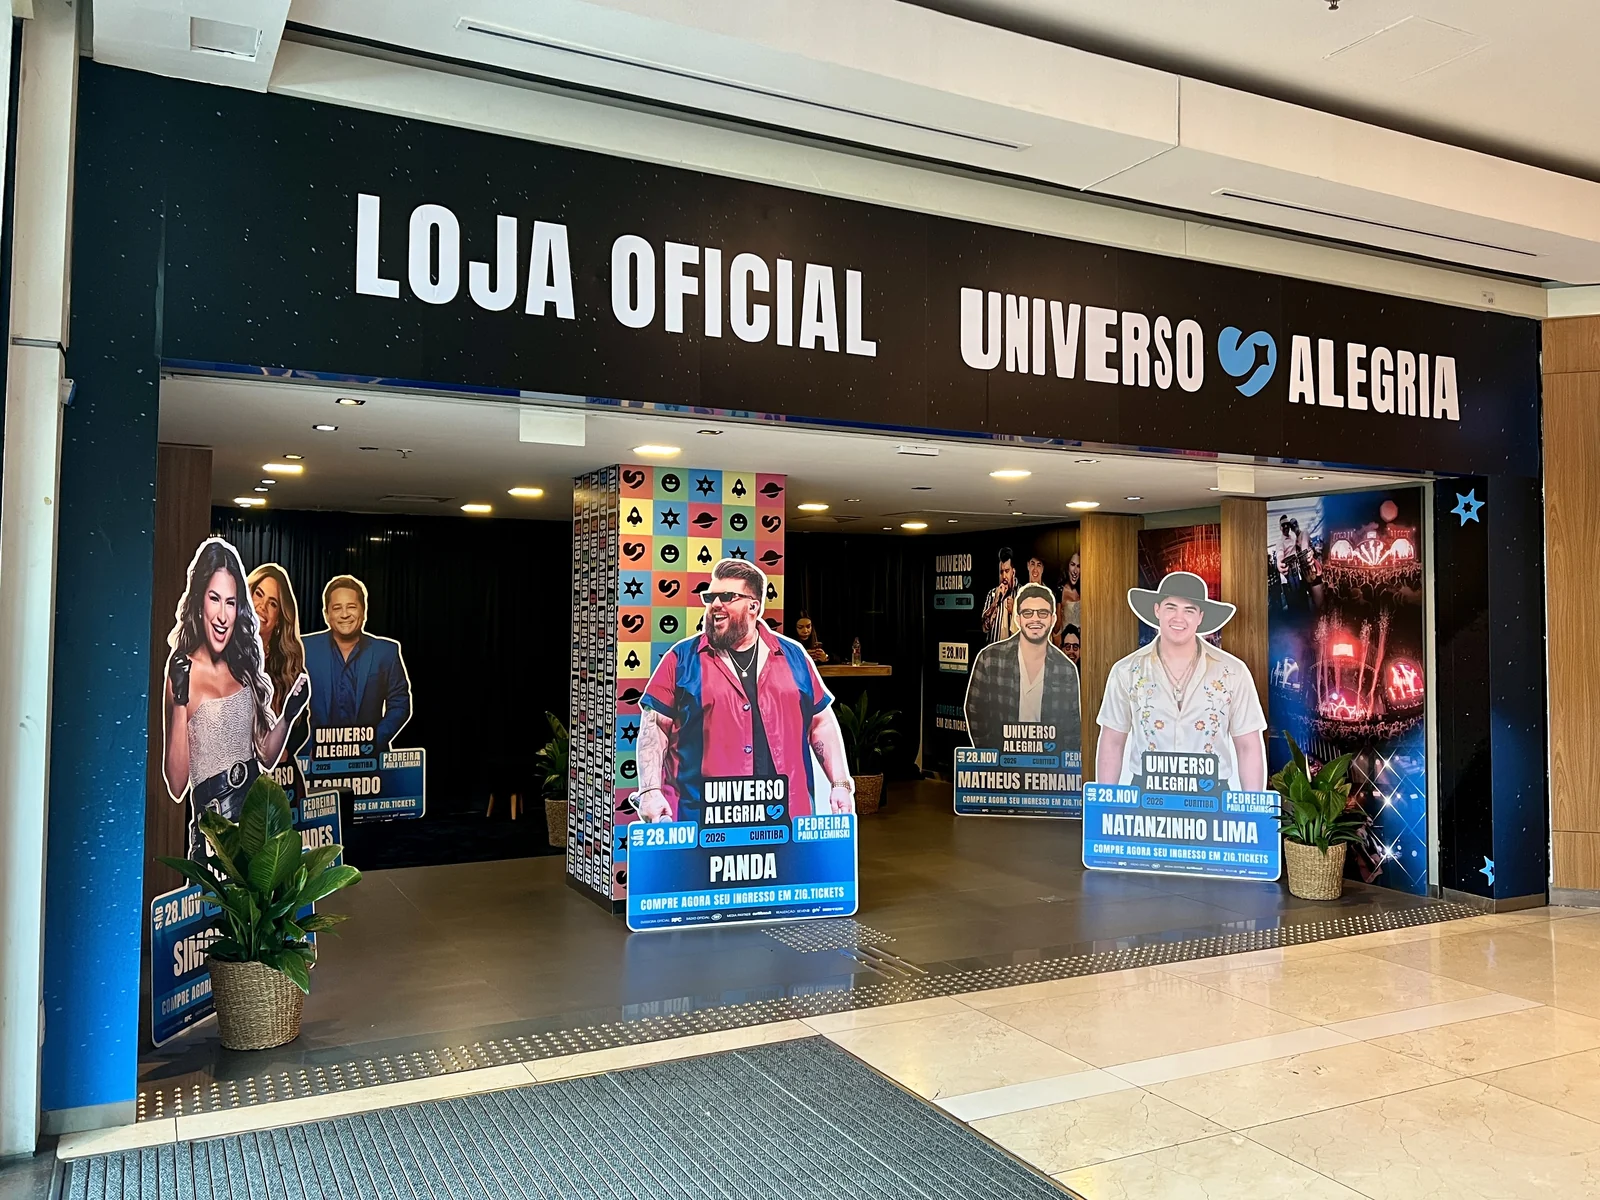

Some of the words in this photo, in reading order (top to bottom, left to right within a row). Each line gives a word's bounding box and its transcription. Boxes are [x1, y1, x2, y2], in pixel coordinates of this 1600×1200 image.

[356, 194, 576, 320] LOJA
[611, 234, 877, 357] OFICIAL
[960, 287, 1204, 393] UNIVERSO
[1288, 334, 1460, 421] ALEGRIA
[598, 520, 607, 598] UNIVERSO
[608, 516, 616, 589] ALEGRIA
[935, 553, 972, 573] UNIVERSO
[935, 575, 963, 590] ALEGRIA
[607, 592, 615, 673] UNIVERSO
[580, 610, 588, 679] ALEGRIA
[597, 610, 605, 682] ALEGRIA
[571, 679, 579, 748] ALEGRIA
[579, 682, 587, 760] UNIVERSO
[587, 681, 595, 753] ALEGRIA
[605, 684, 613, 759] ALEGRIA
[315, 726, 374, 743] UNIVERSO
[595, 685, 604, 766] UNIVERSO
[1002, 724, 1056, 740] UNIVERSO
[315, 744, 360, 758] ALEGRIA
[383, 751, 420, 762] PEDREIRA
[966, 751, 998, 764] 28.NOV
[1003, 741, 1043, 753] ALEGRIA
[1145, 755, 1215, 776] UNIVERSO
[568, 750, 577, 827] UNIVERSO
[704, 779, 785, 803] UNIVERSO
[957, 770, 1021, 790] MATHEUS
[1146, 775, 1198, 793] ALEGRIA
[303, 794, 336, 812] PEDREIRA
[368, 802, 378, 810] EM
[380, 799, 416, 809] ZIG.TICKETS
[585, 755, 594, 835] UNIVERSO
[603, 761, 612, 844] UNIVERSO
[962, 795, 987, 804] COMPRE
[988, 796, 1008, 804] AGORA
[1009, 796, 1020, 805] SEU
[1021, 797, 1050, 806] INGRESSO
[1051, 798, 1061, 806] EM
[1087, 787, 1097, 802] SÁB
[1098, 788, 1139, 804] 28.NOV
[1146, 797, 1164, 806] 2026
[1184, 799, 1214, 809] CURITIBA
[1226, 792, 1275, 806] PEDREIRA
[577, 771, 585, 843] ALEGRIA
[593, 778, 602, 852] ALEGRIA
[704, 804, 766, 825] ALEGRIA
[1226, 804, 1246, 812] PAULO
[1247, 805, 1275, 814] LEMINSKI
[797, 816, 850, 831] PEDREIRA
[797, 830, 819, 840] PAULO
[820, 828, 851, 839] LEMINSKI
[1102, 813, 1208, 841] NATANZINHO
[1212, 819, 1259, 845] LIMA
[631, 828, 644, 847] SÁB
[646, 825, 695, 846] 28.NOV
[705, 832, 726, 844] 2026
[749, 829, 784, 841] CURITIBA
[1093, 844, 1125, 855] COMPRE
[1126, 845, 1151, 857] AGORA
[1153, 847, 1168, 857] SEU
[1169, 848, 1207, 860] INGRESSO
[1208, 850, 1221, 861] EM
[1222, 851, 1269, 865] ZIG.TICKETS
[709, 852, 777, 883] PANDA
[640, 897, 678, 911] COMPRE
[681, 895, 711, 908] AGORA
[714, 894, 730, 906] SEU
[732, 890, 775, 905] INGRESSO
[778, 889, 791, 901] EM
[794, 886, 845, 900] ZIG.TICKETS
[154, 905, 164, 931] SÁB
[165, 891, 201, 927] 28.NOV
[173, 927, 224, 977] SIMO
[161, 989, 190, 1016] COMPRE
